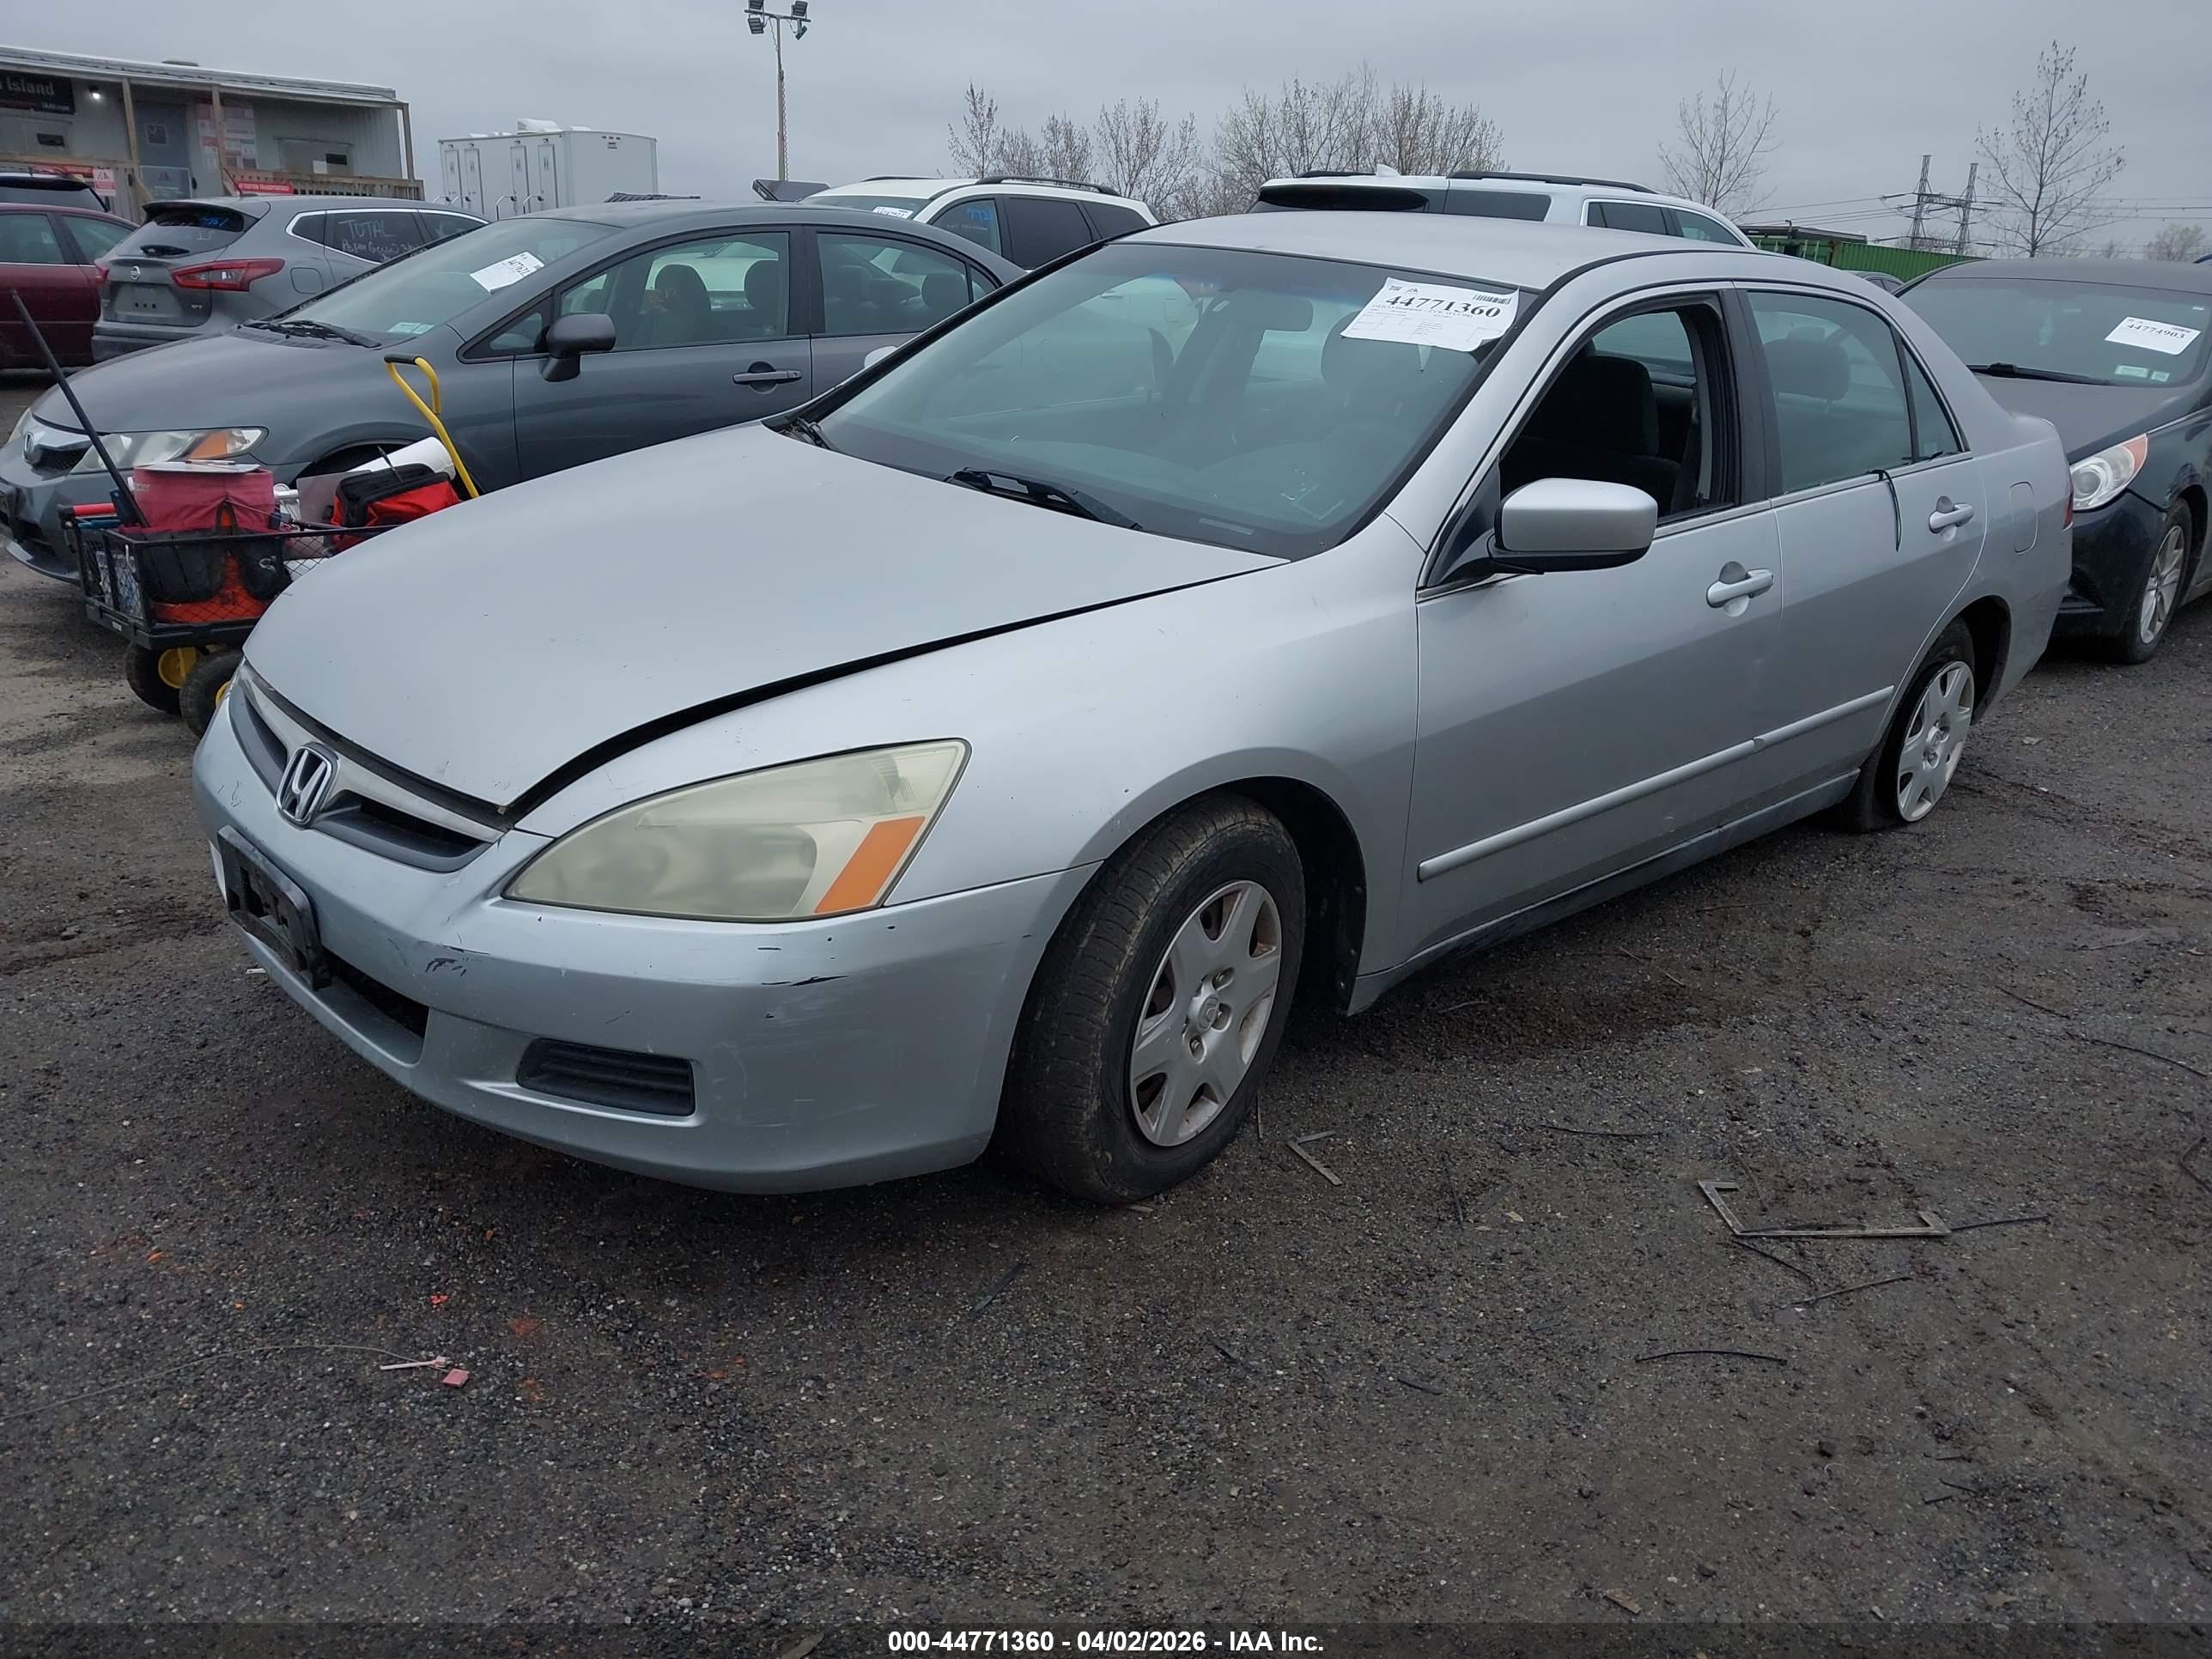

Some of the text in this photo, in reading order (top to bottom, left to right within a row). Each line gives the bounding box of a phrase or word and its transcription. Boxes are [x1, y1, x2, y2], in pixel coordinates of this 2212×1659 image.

[6, 76, 55, 96] Island
[338, 219, 397, 240] TOTAL
[1385, 295, 1502, 318] 44771360
[2127, 324, 2186, 339] 44774903
